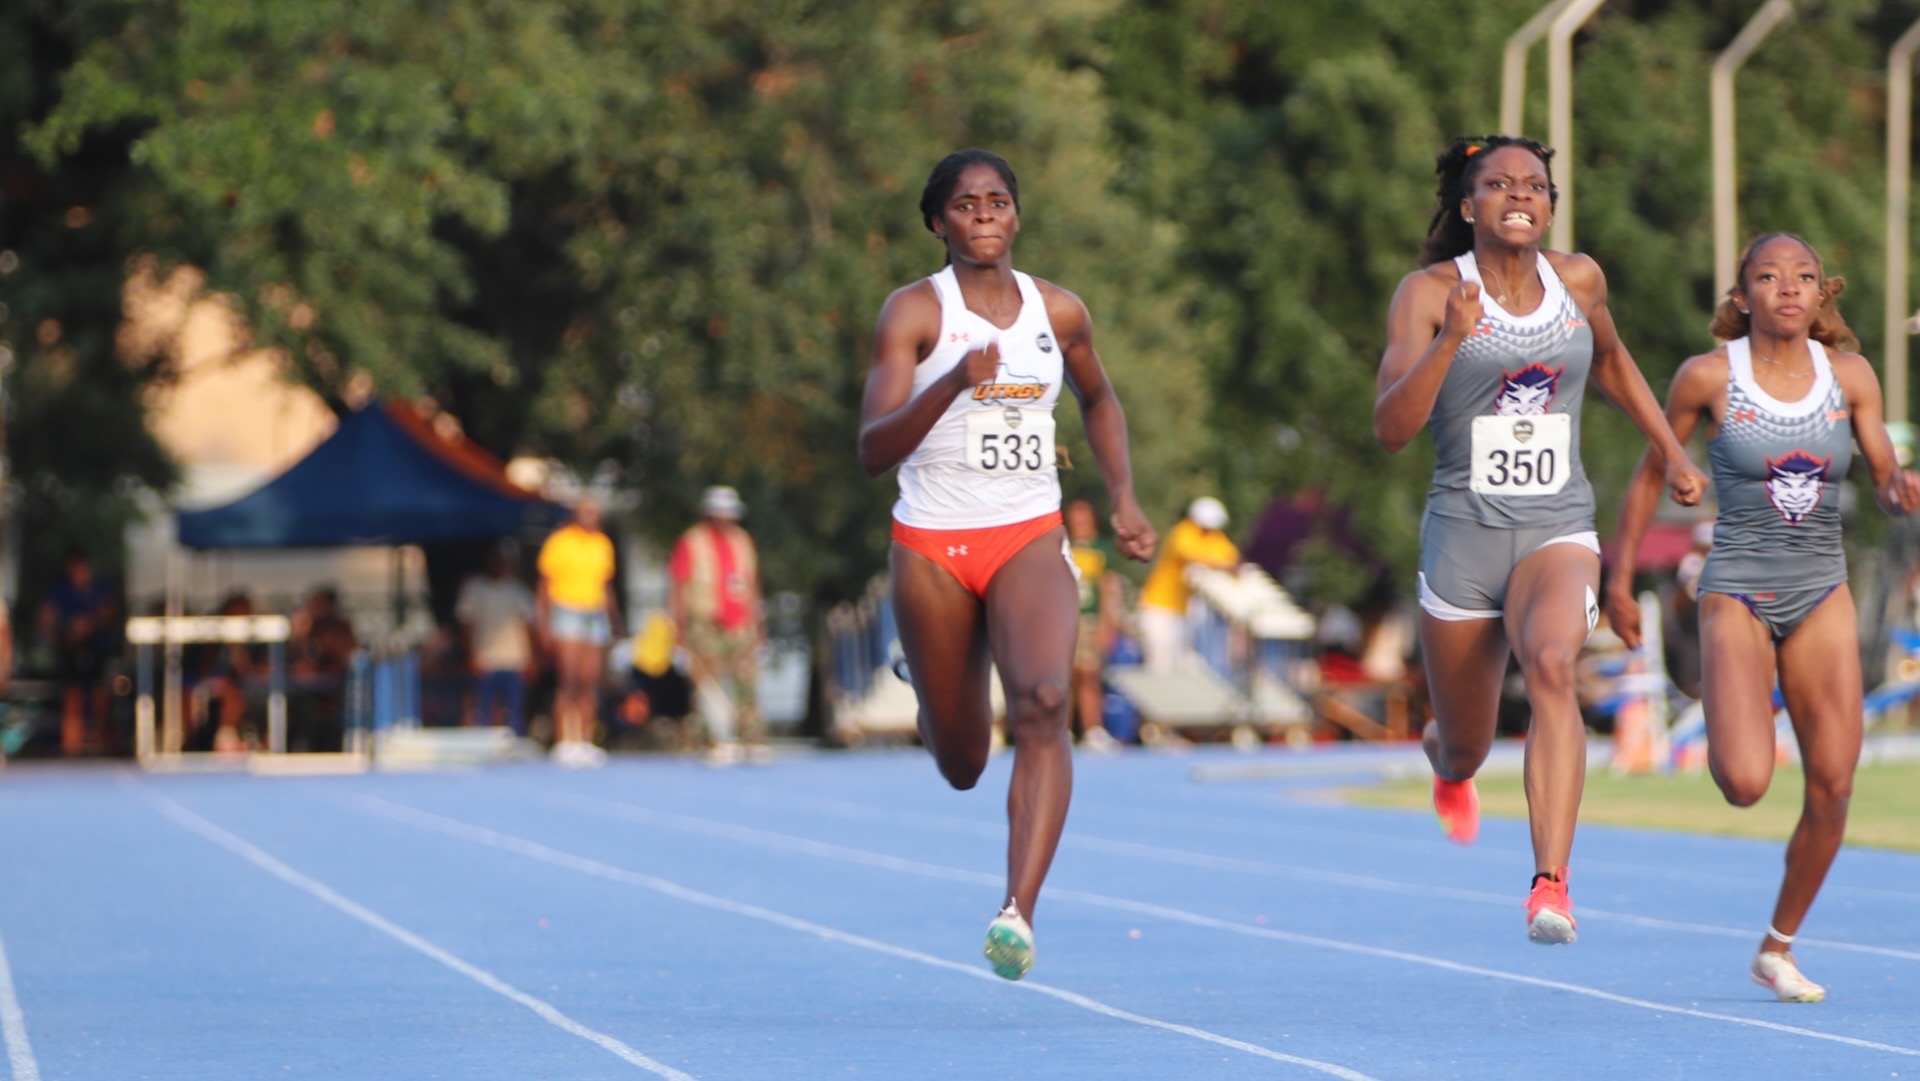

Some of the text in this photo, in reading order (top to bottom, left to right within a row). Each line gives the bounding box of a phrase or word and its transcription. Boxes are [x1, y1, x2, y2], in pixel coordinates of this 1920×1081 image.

[972, 383, 1050, 401] UTRGV
[981, 433, 1041, 471] 533
[1487, 448, 1555, 486] 350
